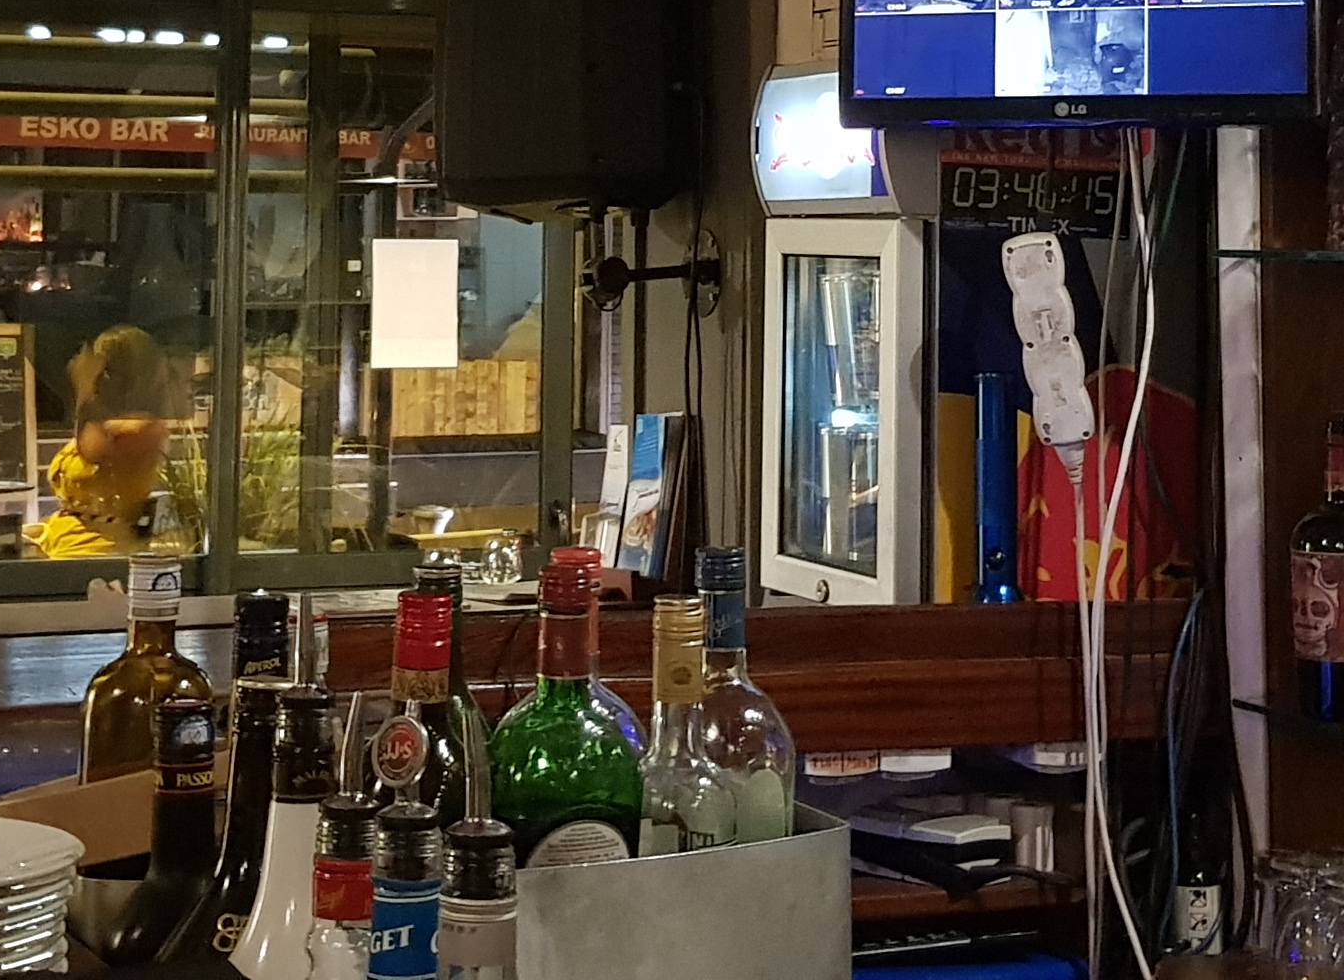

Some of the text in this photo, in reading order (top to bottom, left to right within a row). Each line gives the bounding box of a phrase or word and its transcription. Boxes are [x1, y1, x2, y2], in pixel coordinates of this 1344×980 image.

[1070, 104, 1088, 115] LG
[20, 115, 100, 141] ESKO
[110, 118, 169, 143] BAR
[338, 129, 372, 146] BAR
[243, 656, 282, 676] APEROL
[176, 772, 214, 788] PASSO
[369, 924, 415, 954] GET
